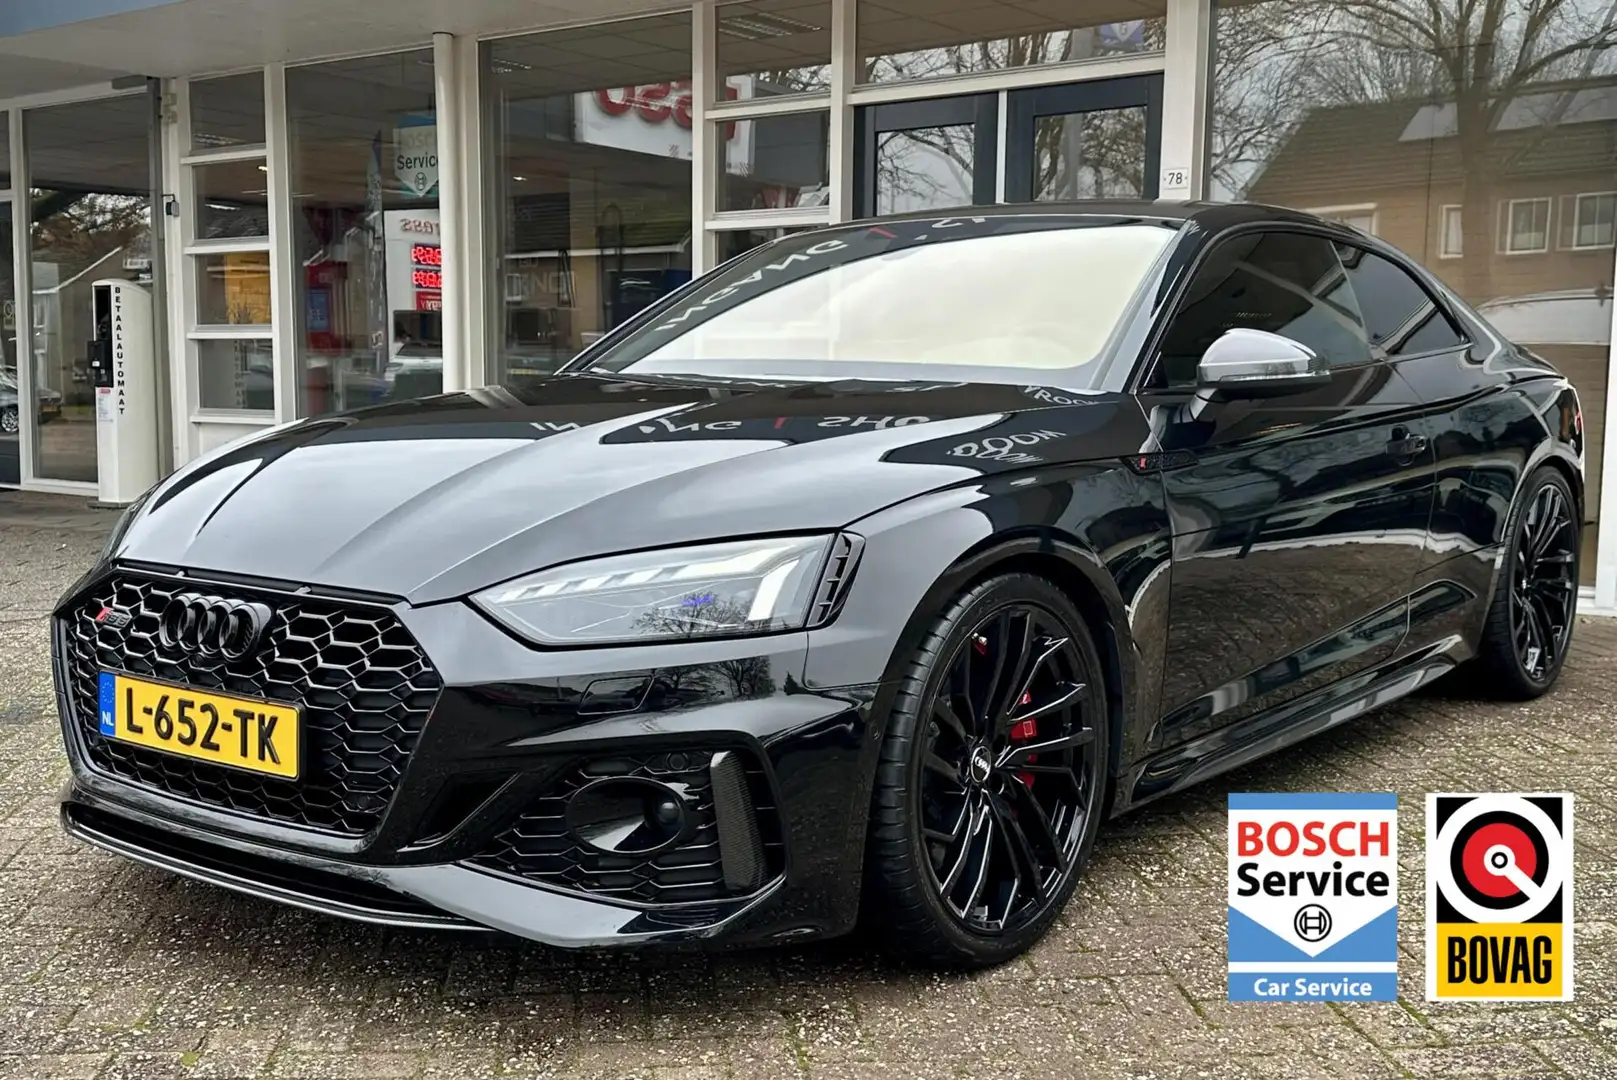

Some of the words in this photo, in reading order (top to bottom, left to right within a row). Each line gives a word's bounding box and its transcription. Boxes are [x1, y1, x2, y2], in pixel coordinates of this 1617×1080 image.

[396, 151, 438, 170] Servic
[1168, 172, 1183, 185] 78
[114, 286, 125, 415] BETAALAUTOMAAT
[102, 711, 114, 727] NL
[126, 687, 281, 765] L-652-TK
